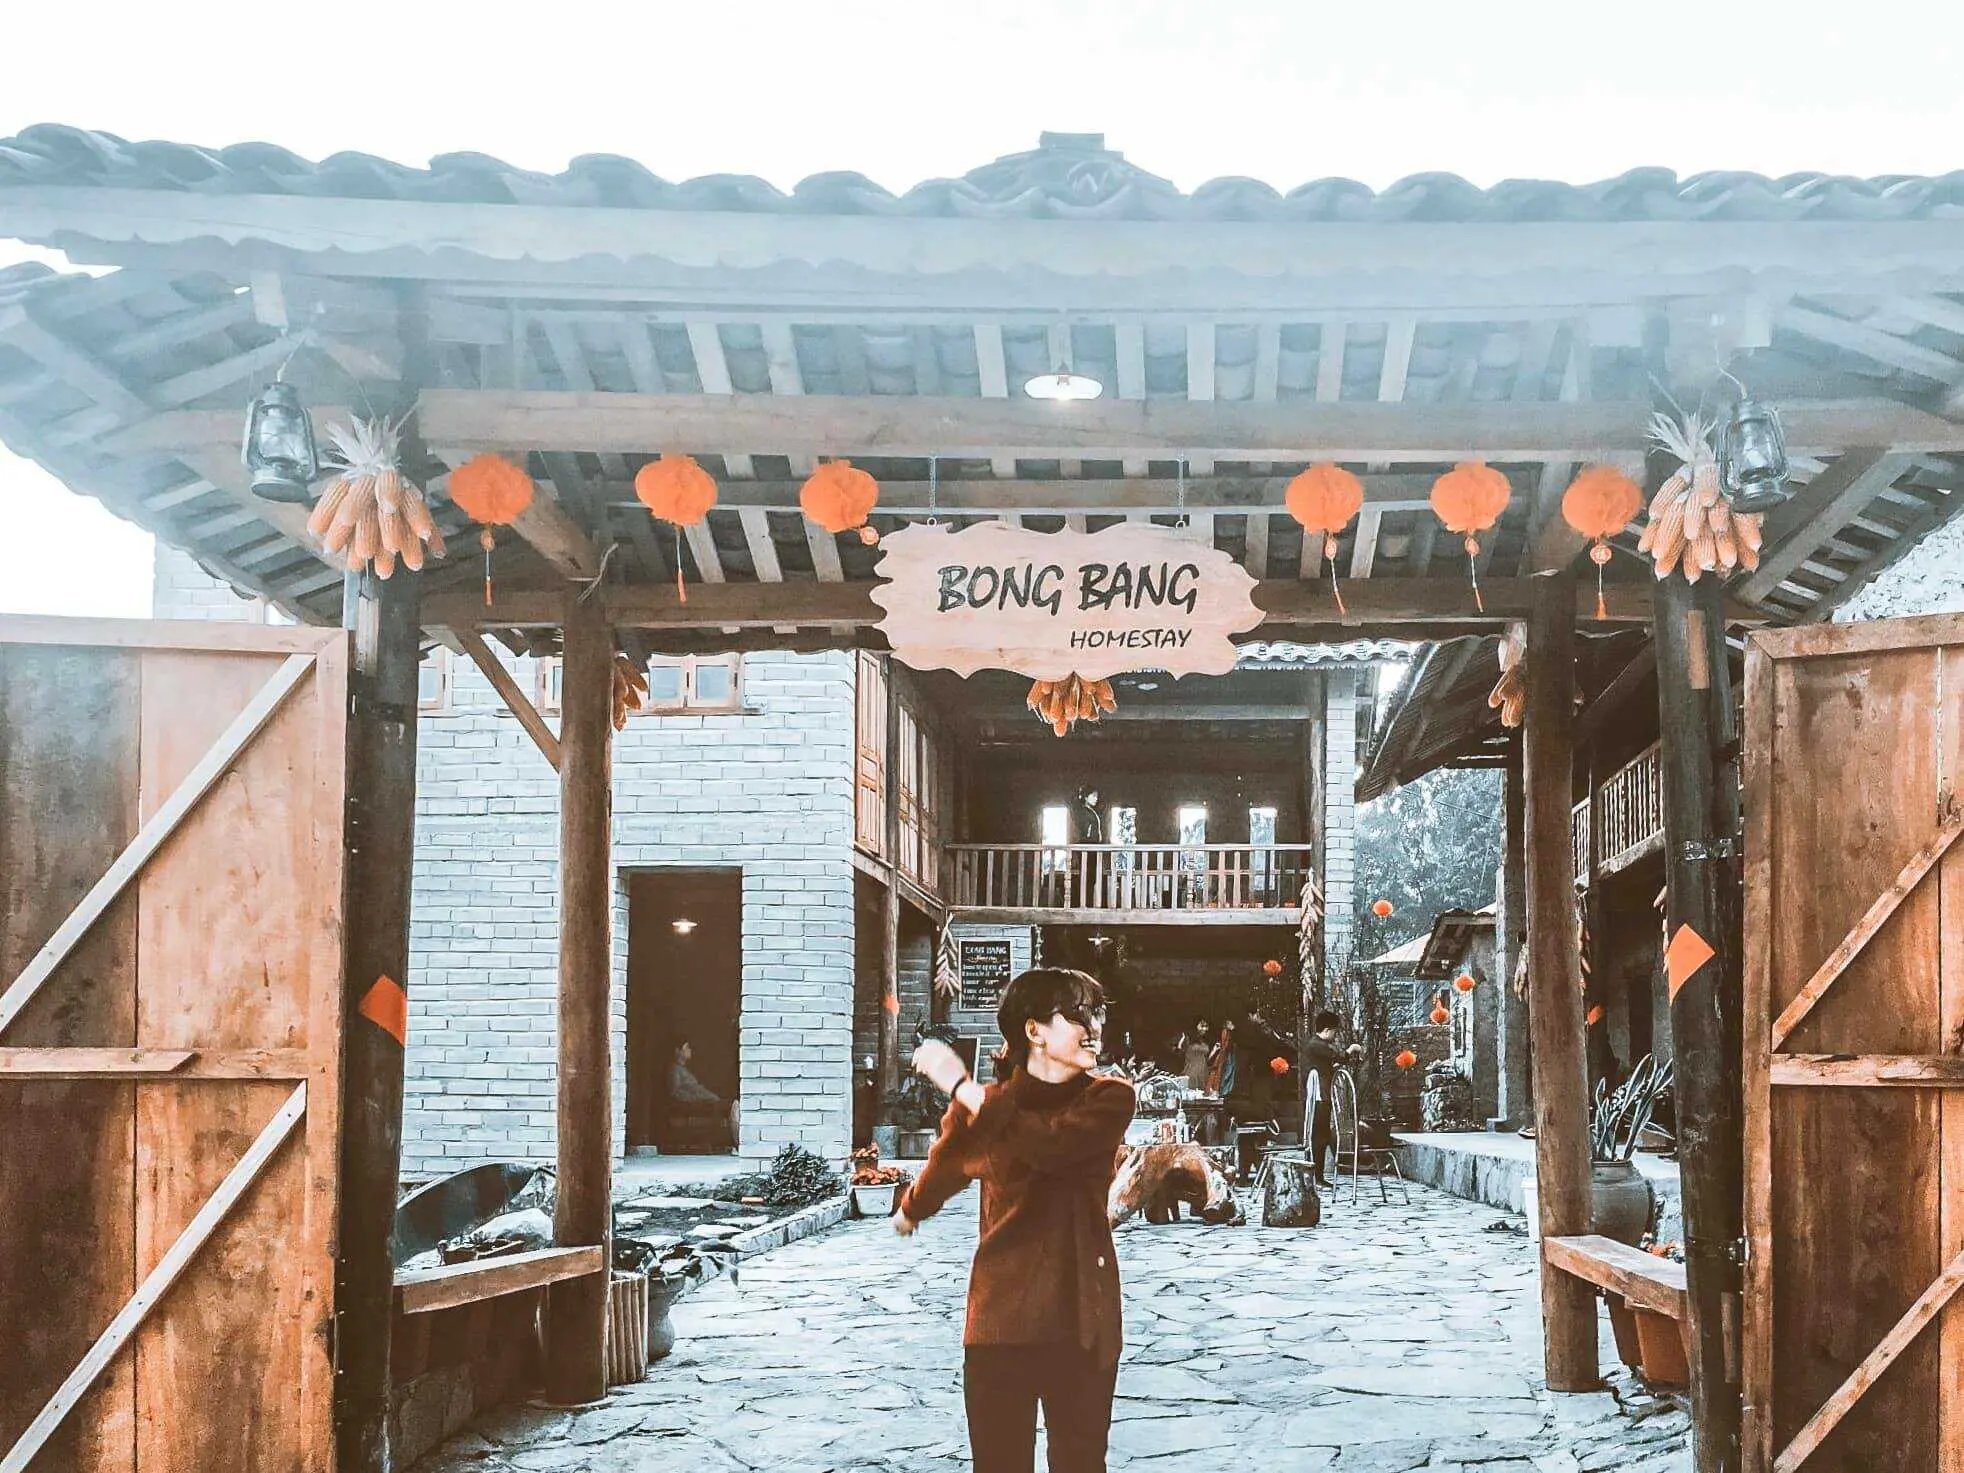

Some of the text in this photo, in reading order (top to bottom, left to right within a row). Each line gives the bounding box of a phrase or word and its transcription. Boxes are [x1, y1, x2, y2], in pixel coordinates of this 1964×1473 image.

[937, 561, 1199, 616] BONG BANG
[1070, 628, 1193, 649] HOMESTAY
